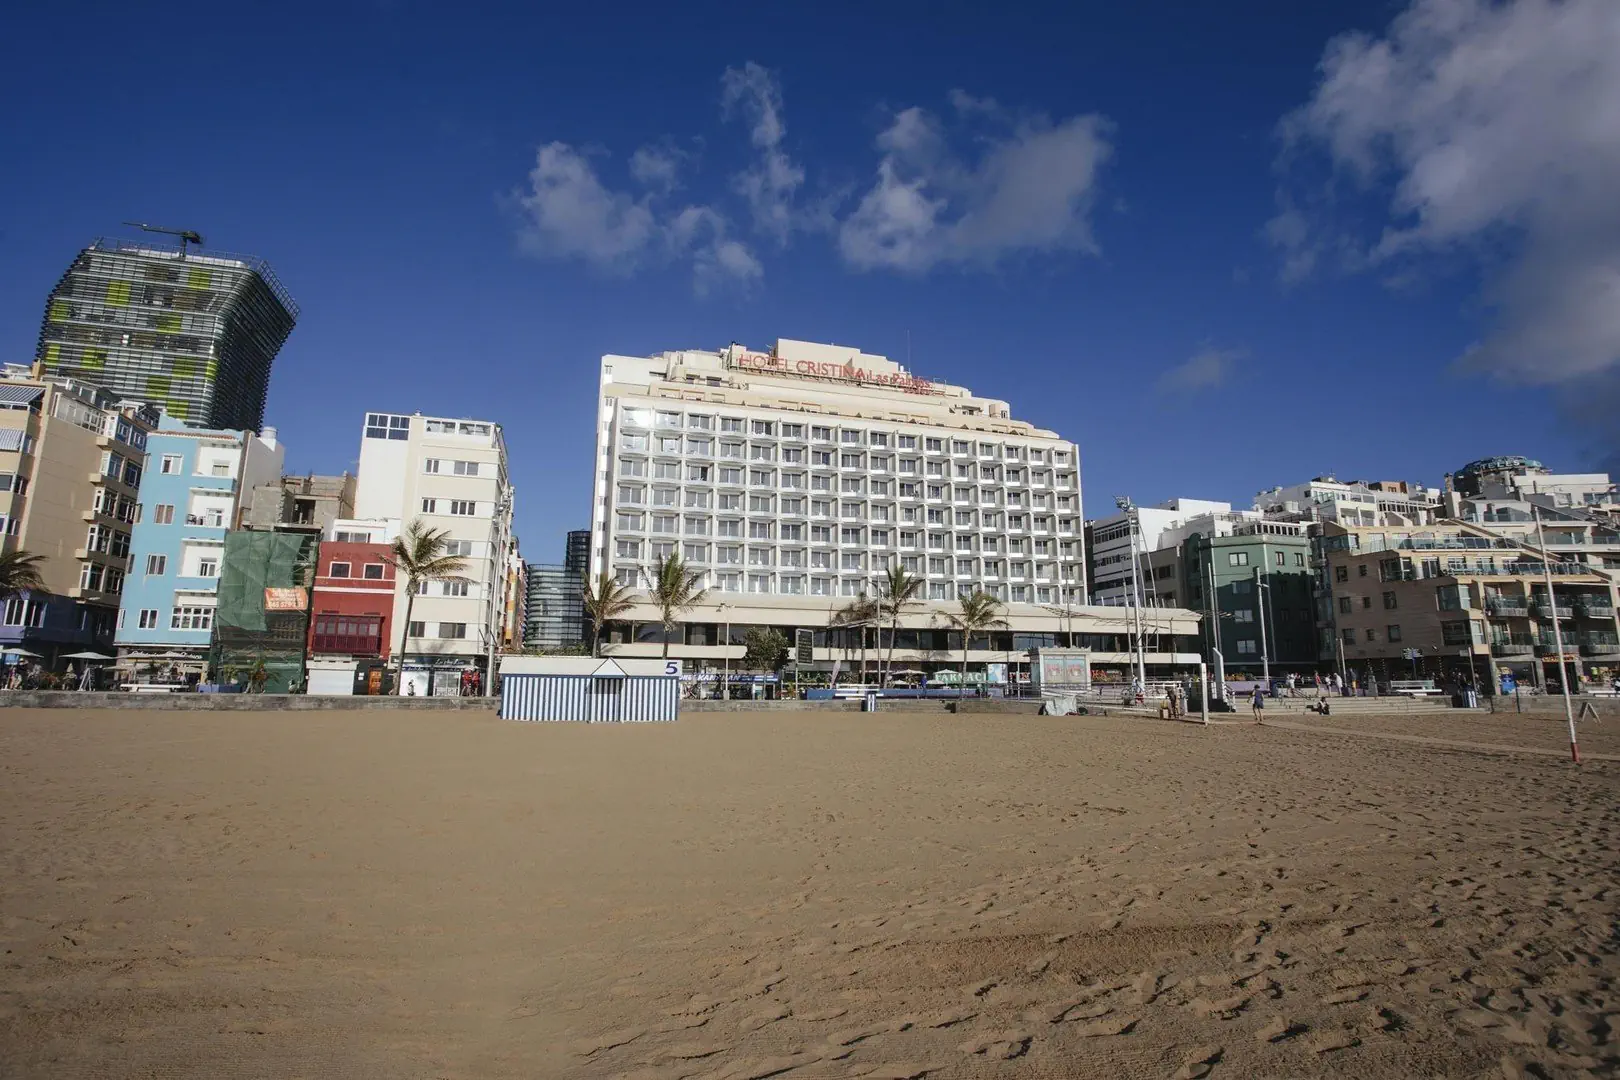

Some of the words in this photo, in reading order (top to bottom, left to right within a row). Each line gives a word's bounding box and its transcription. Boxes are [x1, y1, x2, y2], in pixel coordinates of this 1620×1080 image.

[739, 354, 793, 371] HOTEL
[796, 360, 866, 381] CRISTINA
[868, 369, 888, 383] Las
[665, 661, 678, 674] 5
[935, 672, 987, 681] FARMACI
